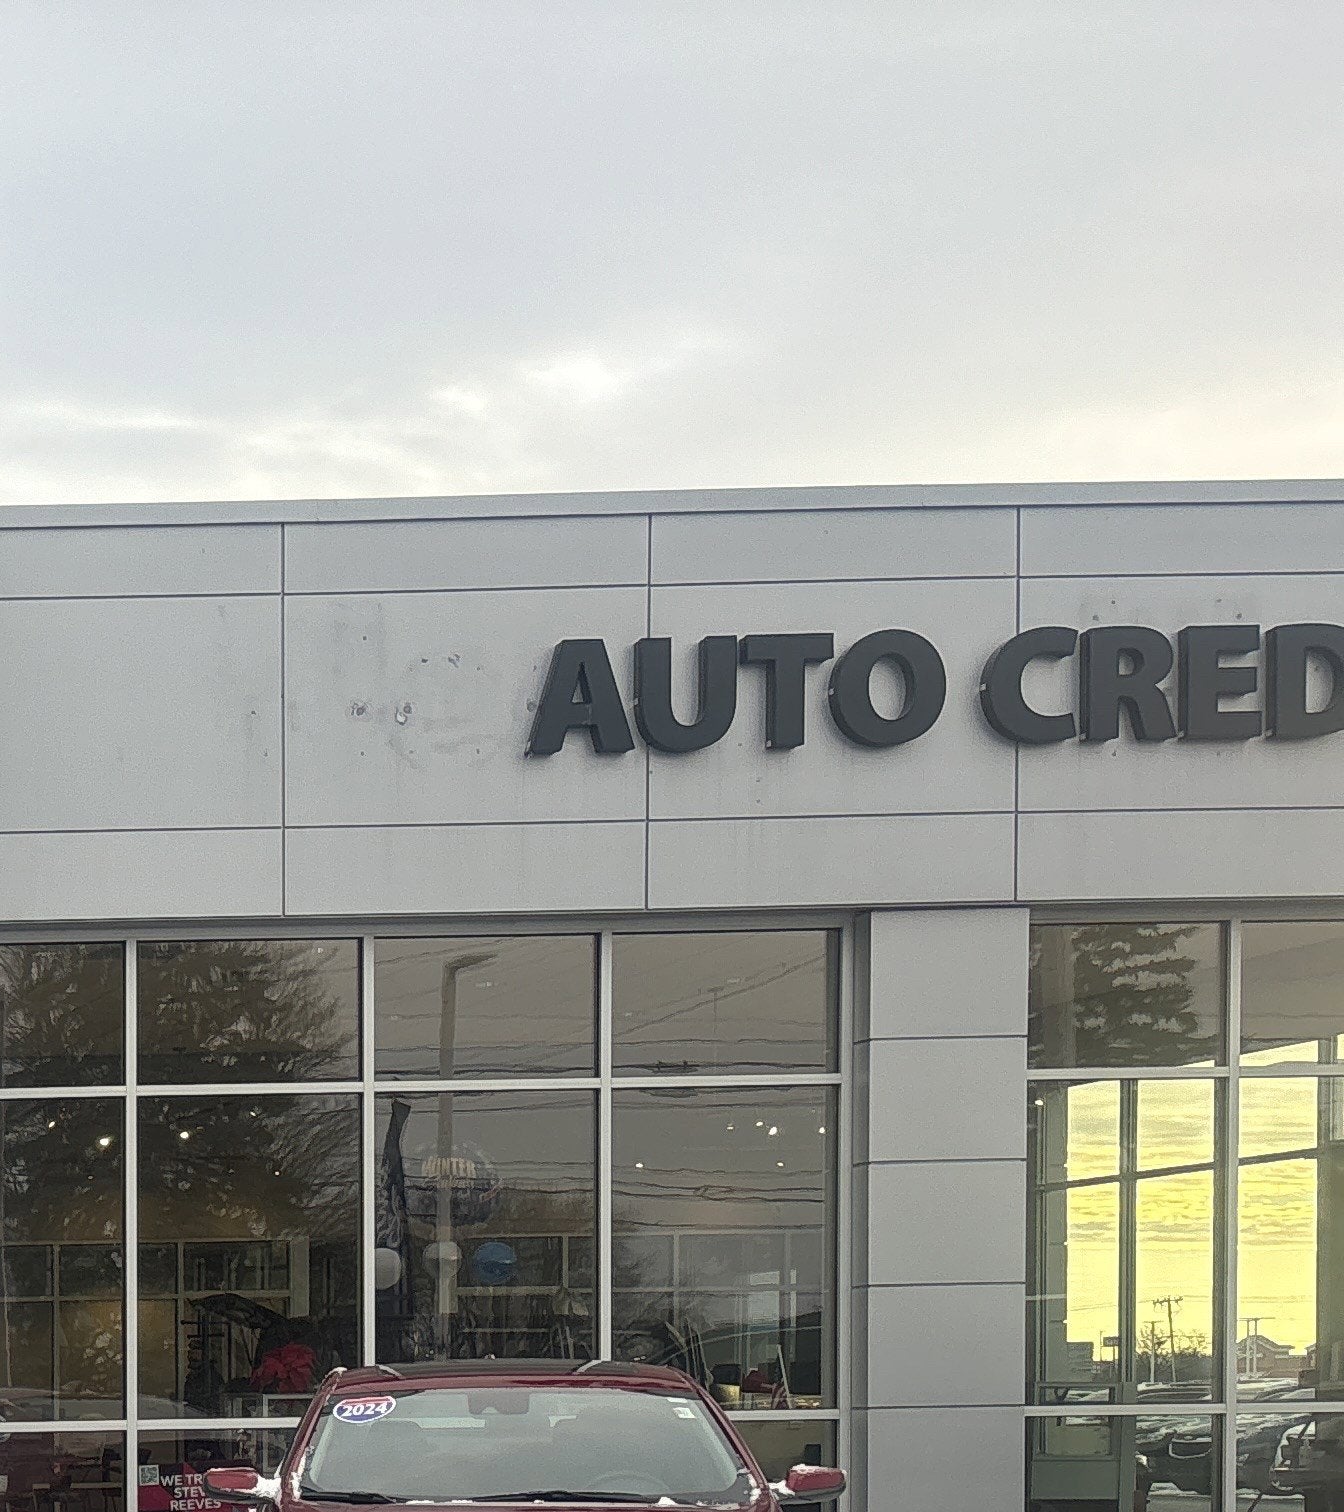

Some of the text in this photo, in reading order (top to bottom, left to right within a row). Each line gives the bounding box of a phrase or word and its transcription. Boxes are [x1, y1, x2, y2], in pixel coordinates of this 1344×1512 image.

[525, 628, 947, 757] AUTO
[341, 1401, 389, 1417] 2024
[160, 1473, 204, 1487] WE TR
[173, 1486, 206, 1499] STEV
[170, 1499, 221, 1511] REEVES
